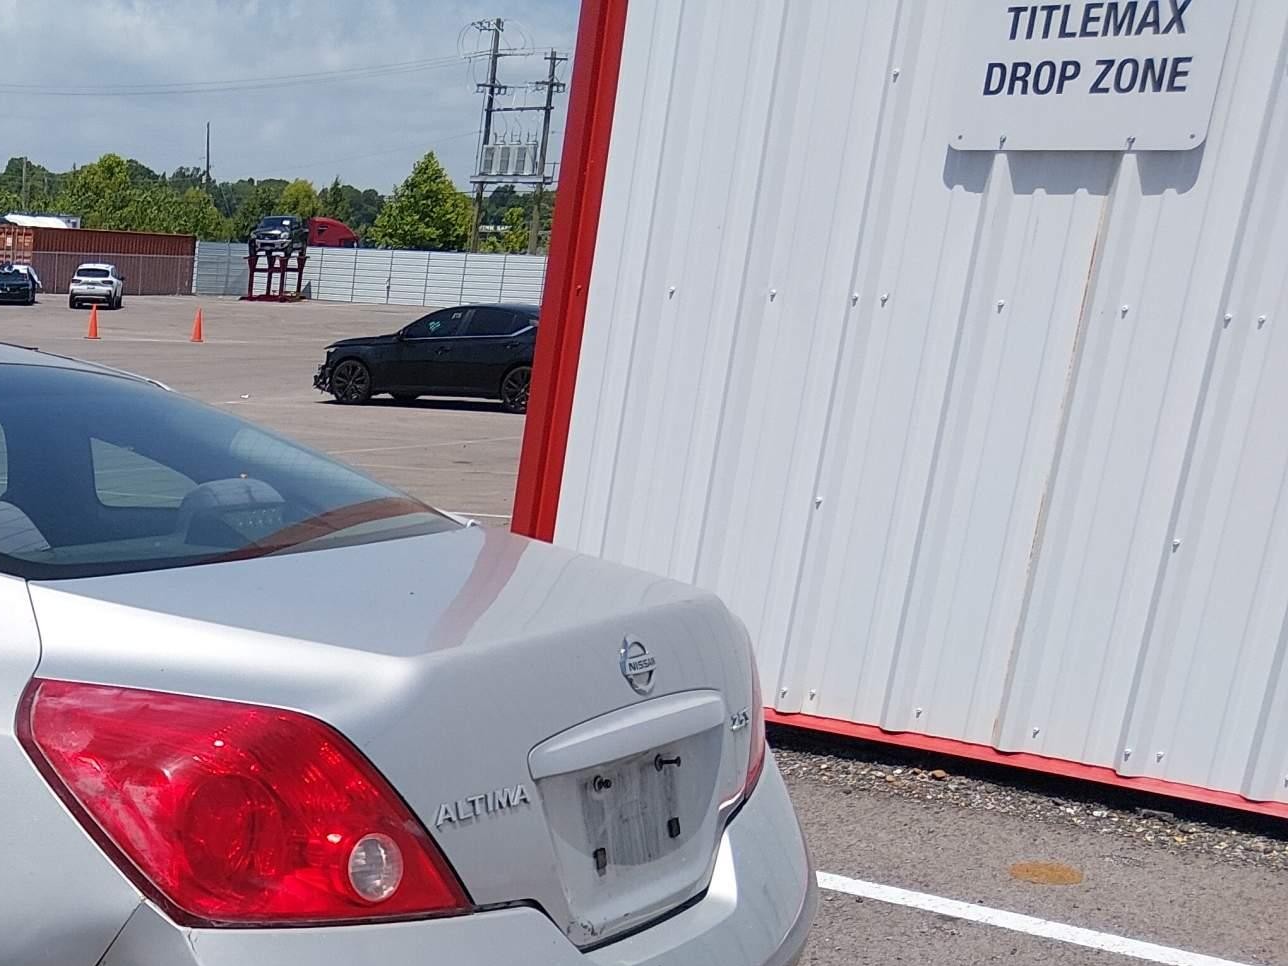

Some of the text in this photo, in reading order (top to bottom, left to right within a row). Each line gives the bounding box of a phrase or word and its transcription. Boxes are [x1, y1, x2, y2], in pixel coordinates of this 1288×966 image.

[1007, 0, 1192, 40] TITLEMAX
[982, 56, 1193, 95] DROP ZONE
[627, 656, 656, 672] NISSAN
[435, 785, 529, 829] ALTIMA
